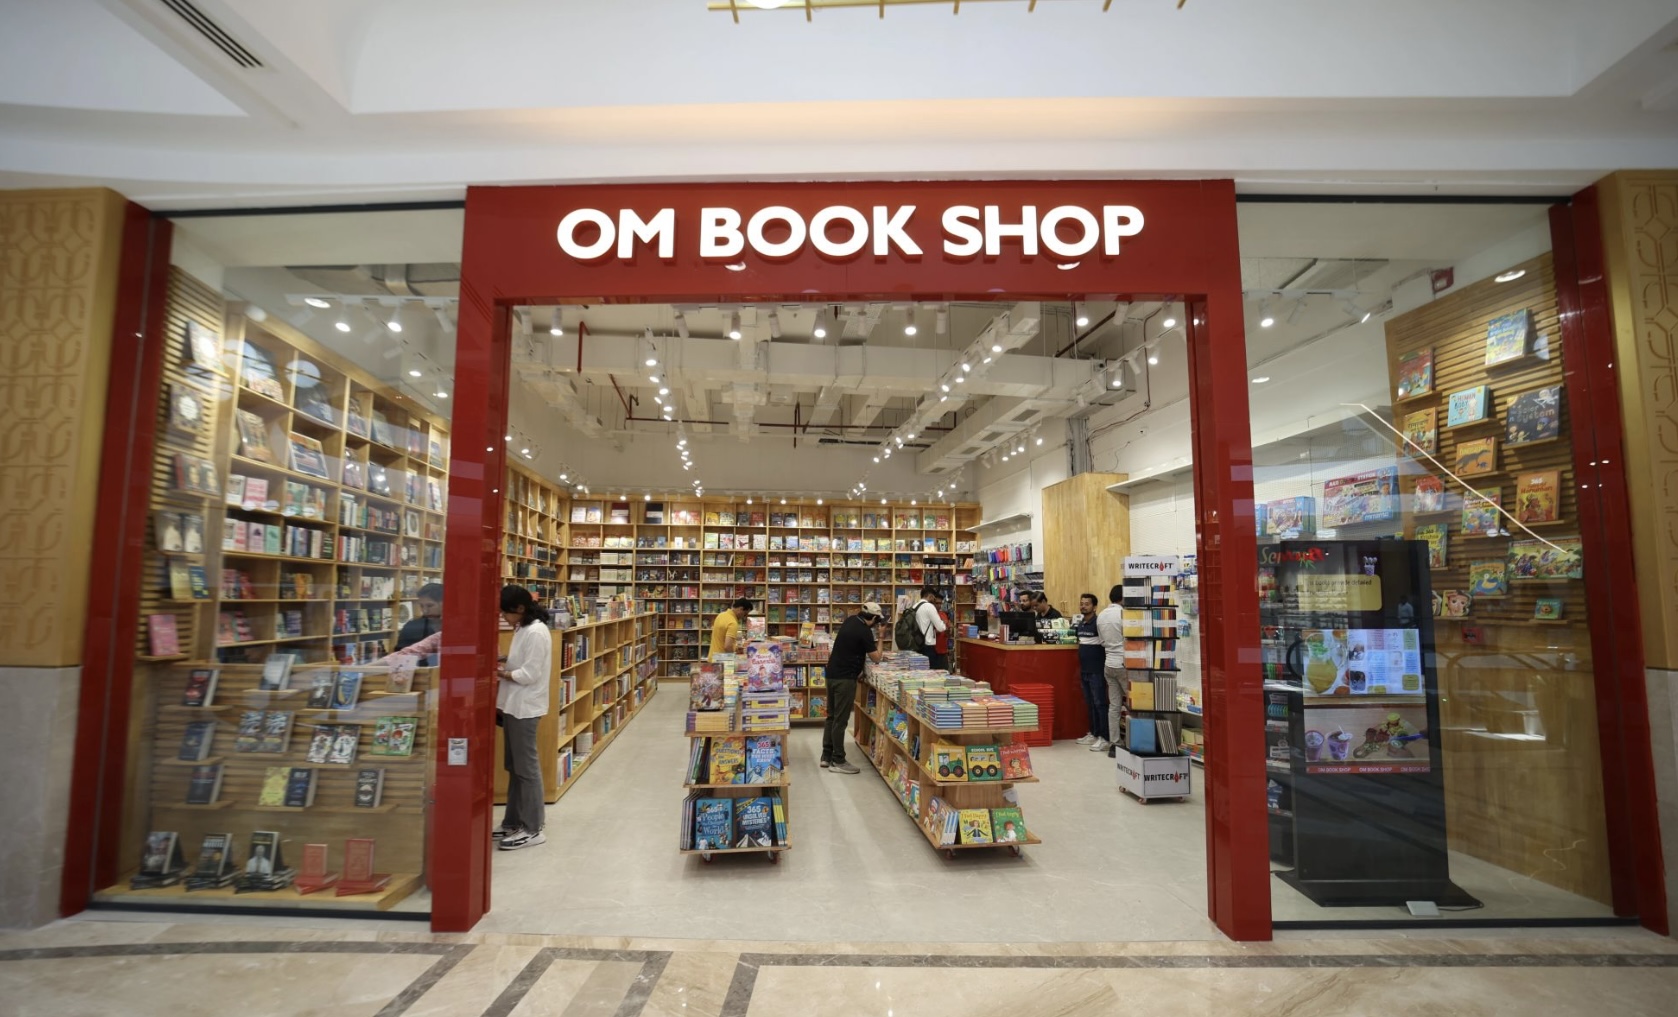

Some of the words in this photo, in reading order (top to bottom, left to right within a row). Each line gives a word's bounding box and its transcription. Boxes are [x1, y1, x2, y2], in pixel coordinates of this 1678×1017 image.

[556, 208, 676, 260] OM
[700, 205, 924, 258] BOOK
[942, 205, 1145, 257] SHOP
[747, 805, 761, 813] 365
[702, 812, 725, 823] People
[703, 826, 725, 836] World
